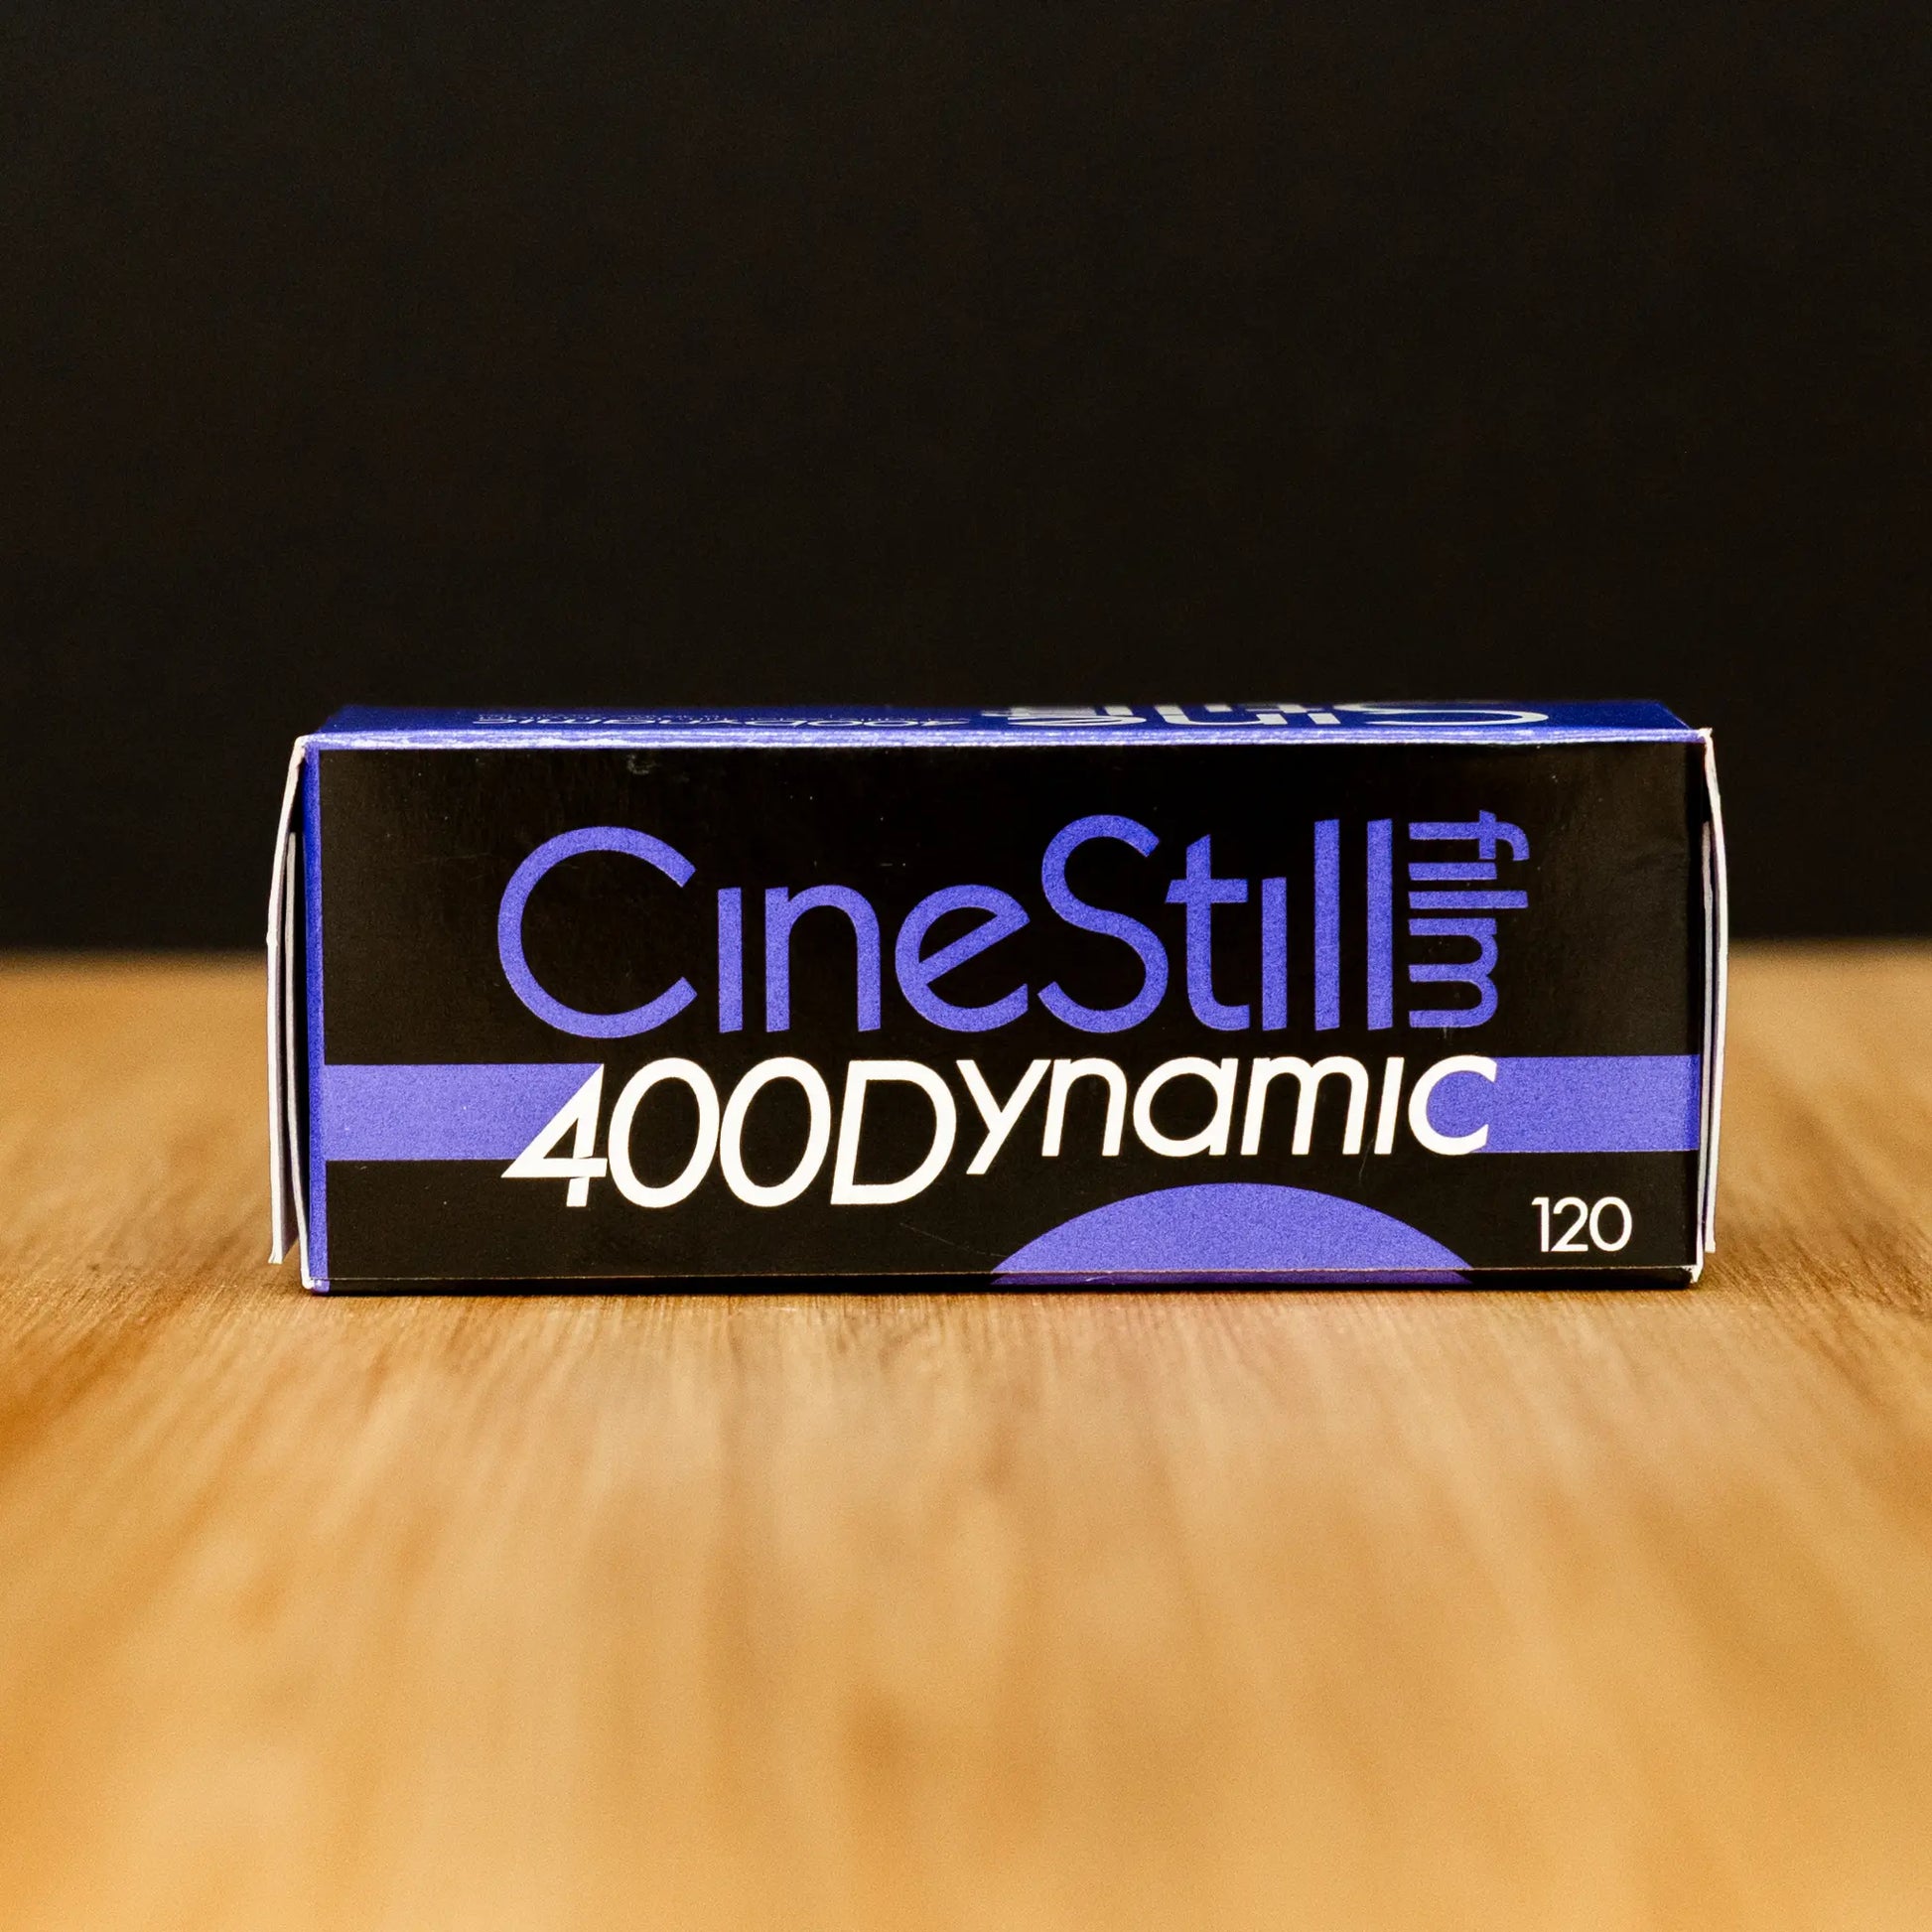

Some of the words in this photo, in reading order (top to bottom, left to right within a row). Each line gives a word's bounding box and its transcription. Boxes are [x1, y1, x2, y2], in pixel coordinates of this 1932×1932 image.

[497, 814, 1393, 1037] CineStill
[1408, 809, 1530, 1029] film
[500, 1054, 1497, 1208] 400Dynamic
[1531, 1196, 1632, 1253] 120
